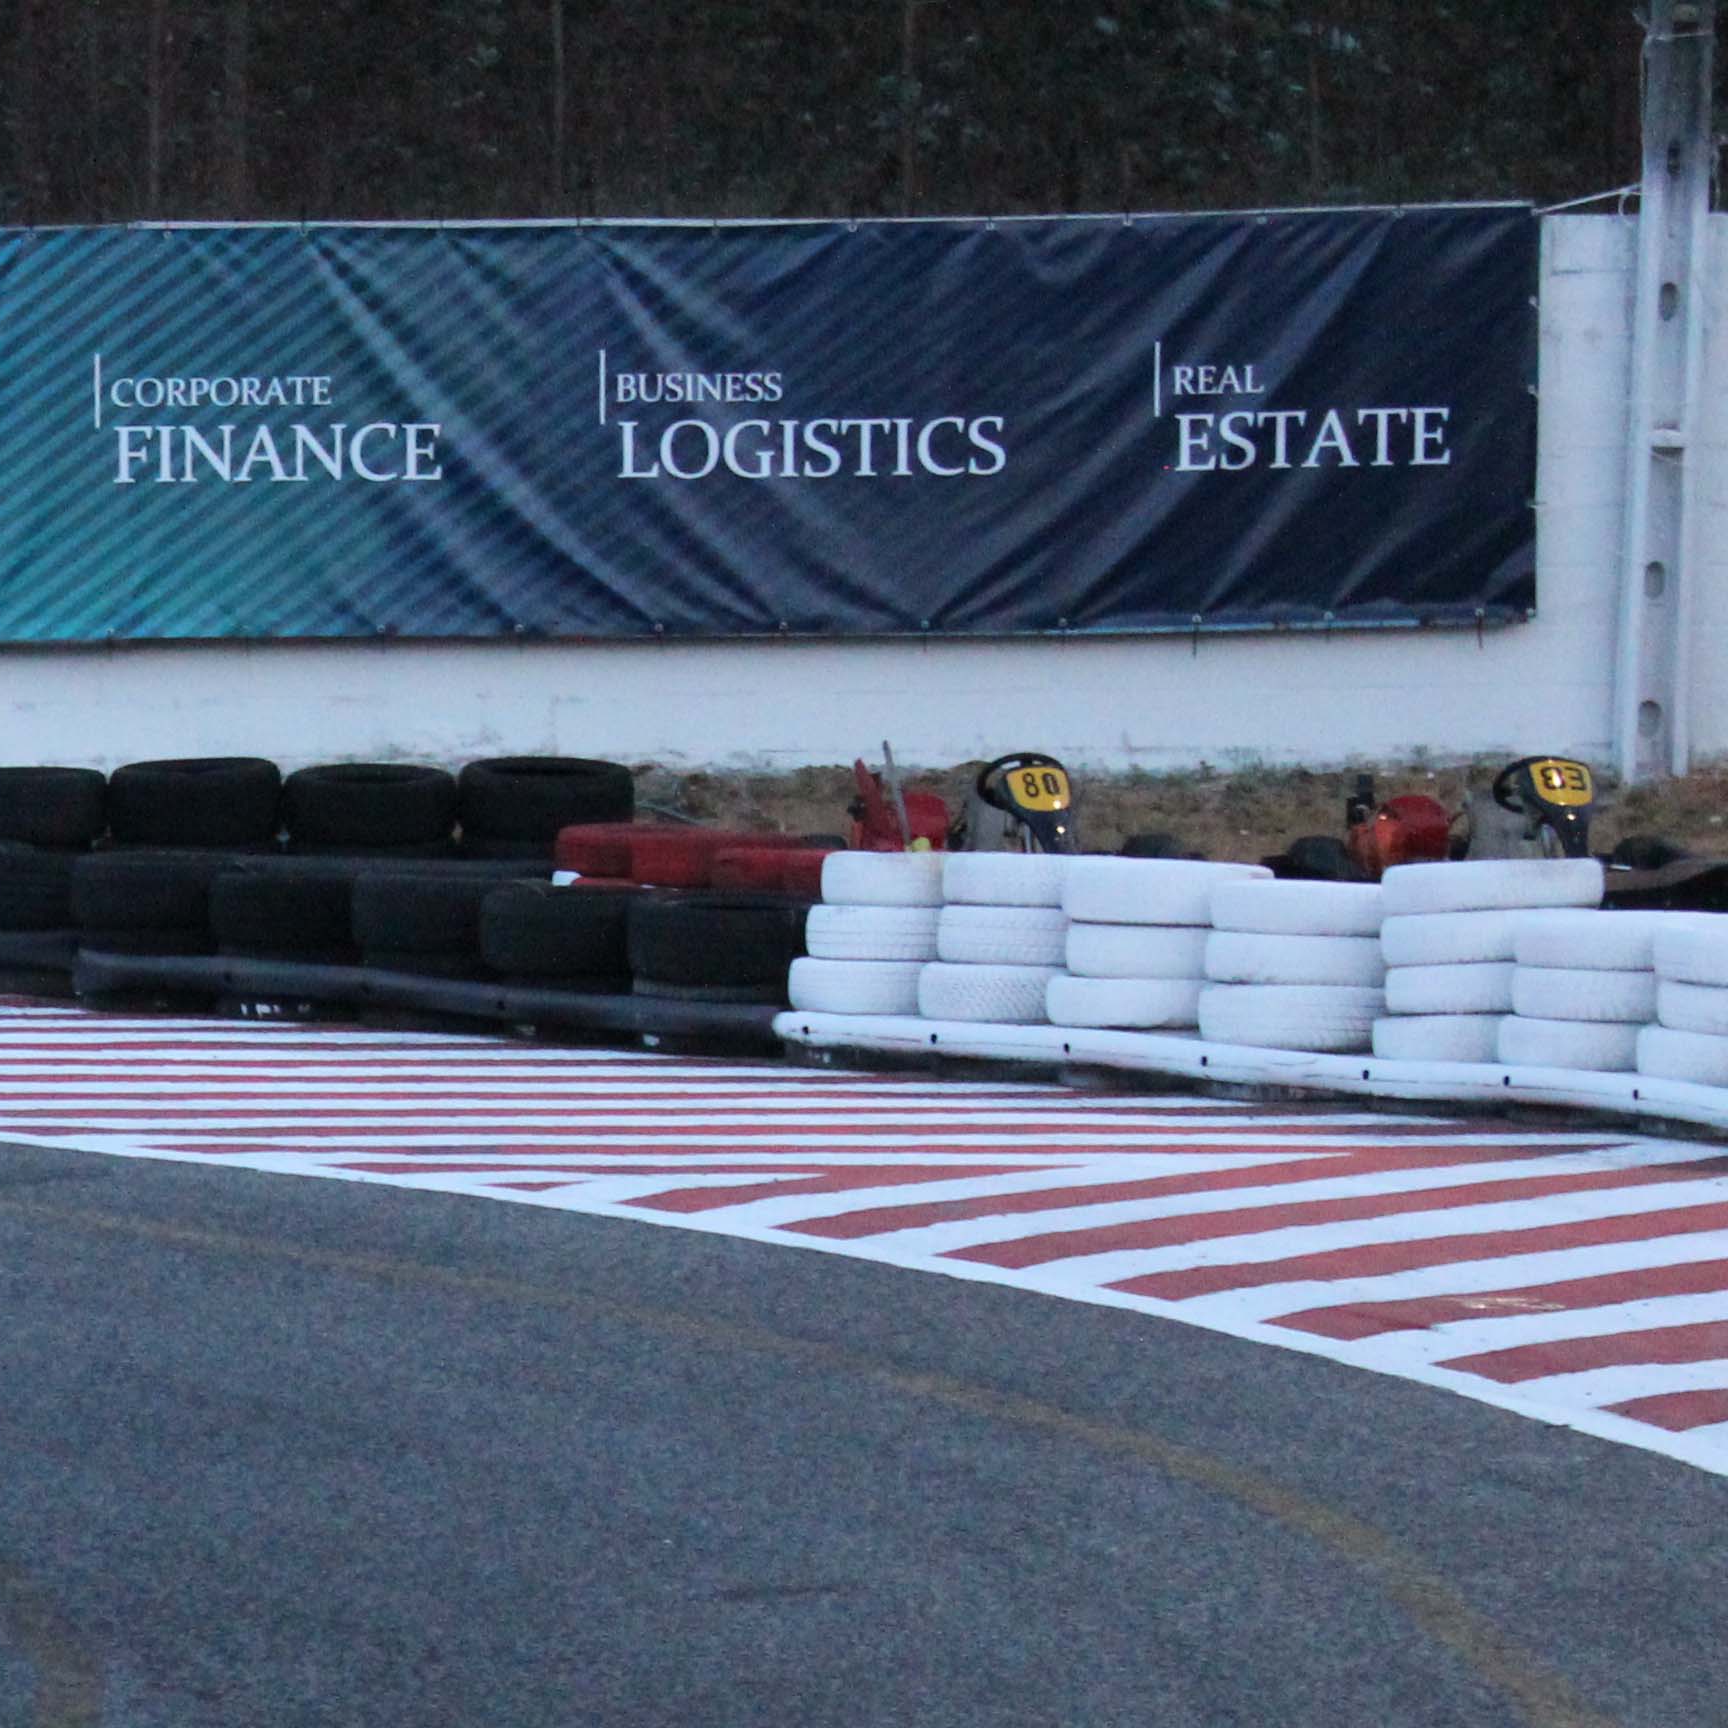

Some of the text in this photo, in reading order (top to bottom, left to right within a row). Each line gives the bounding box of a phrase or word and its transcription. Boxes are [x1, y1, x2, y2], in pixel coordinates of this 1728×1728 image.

[110, 376, 333, 407] CORPORATE
[616, 372, 783, 403] BUSINESS
[1172, 364, 1265, 395] REAL
[112, 422, 443, 483] FINANCE
[616, 416, 1007, 480] LOGISTICS
[1174, 407, 1451, 472] ESTATE
